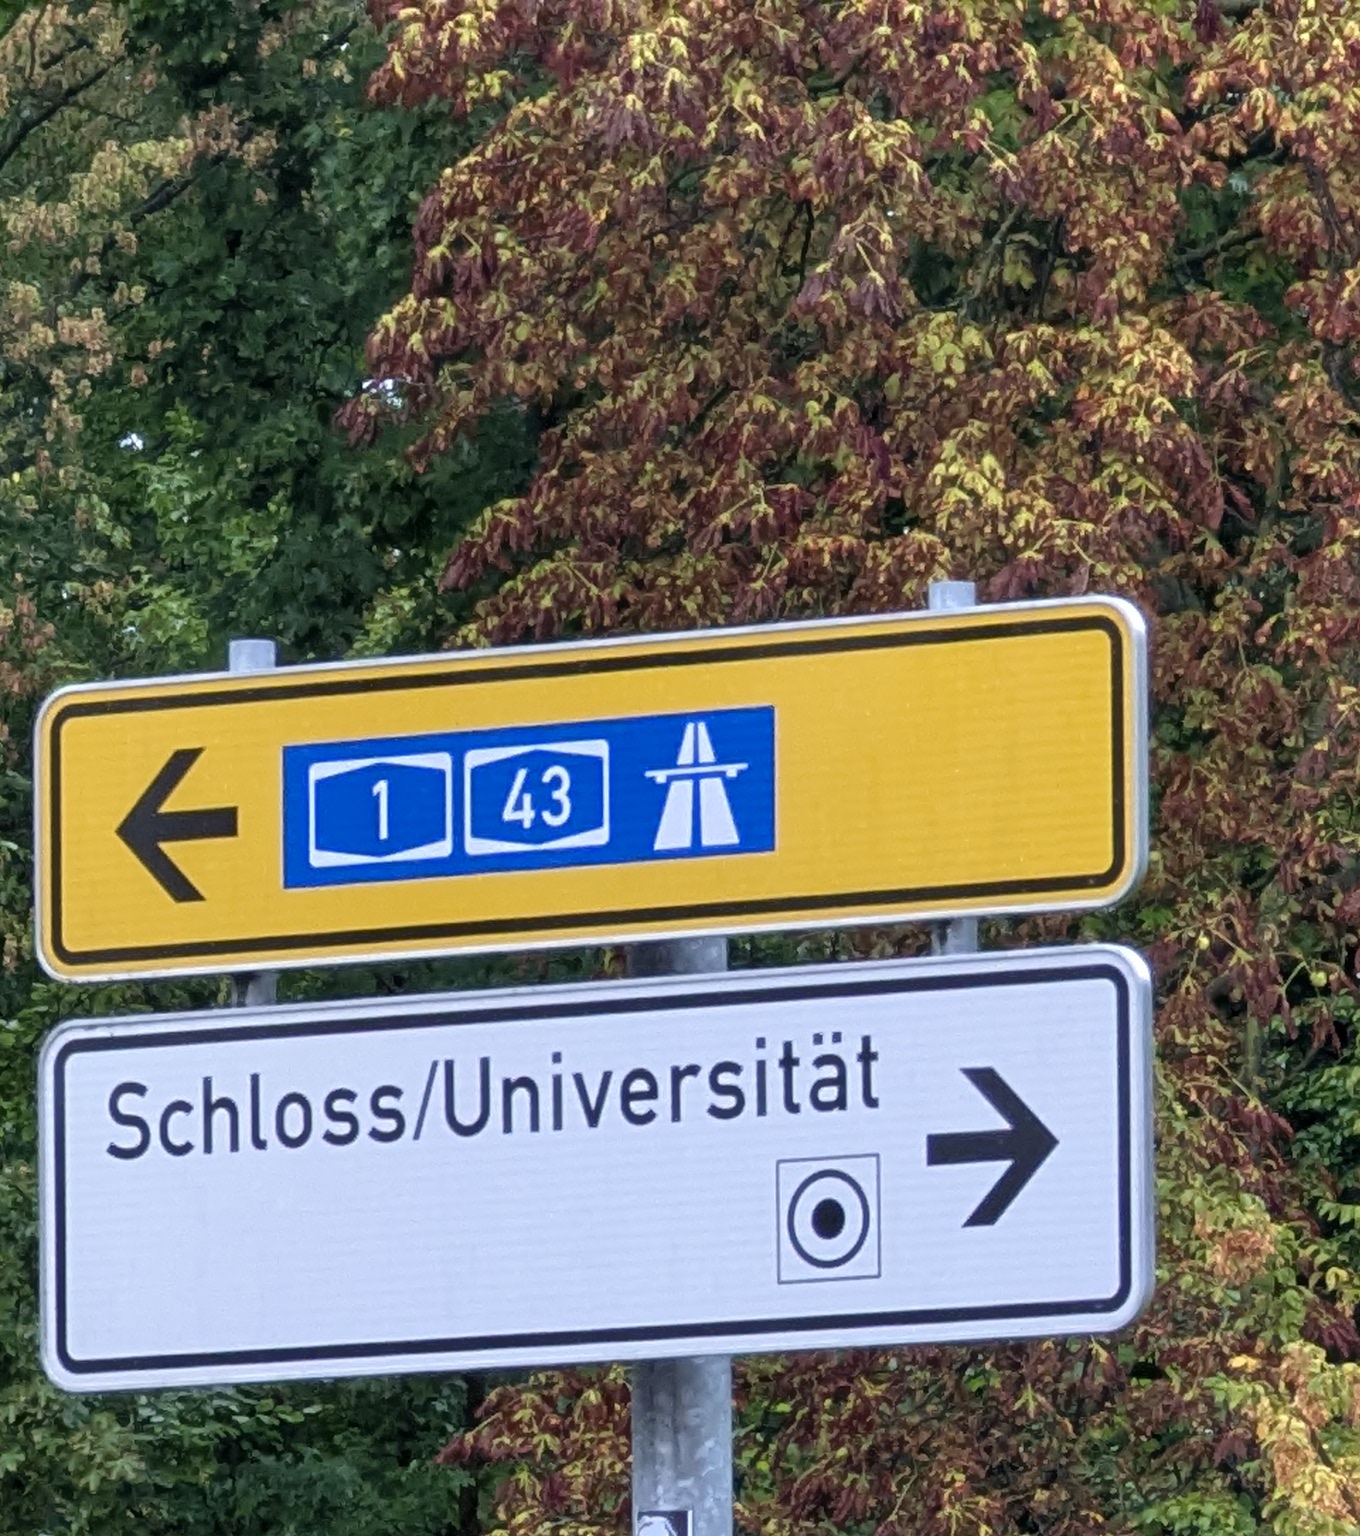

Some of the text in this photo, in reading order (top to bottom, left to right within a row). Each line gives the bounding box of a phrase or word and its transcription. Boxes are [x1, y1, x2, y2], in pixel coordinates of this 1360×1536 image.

[371, 765, 571, 840] 1 43
[106, 1031, 879, 1160] Schloss/Universität
